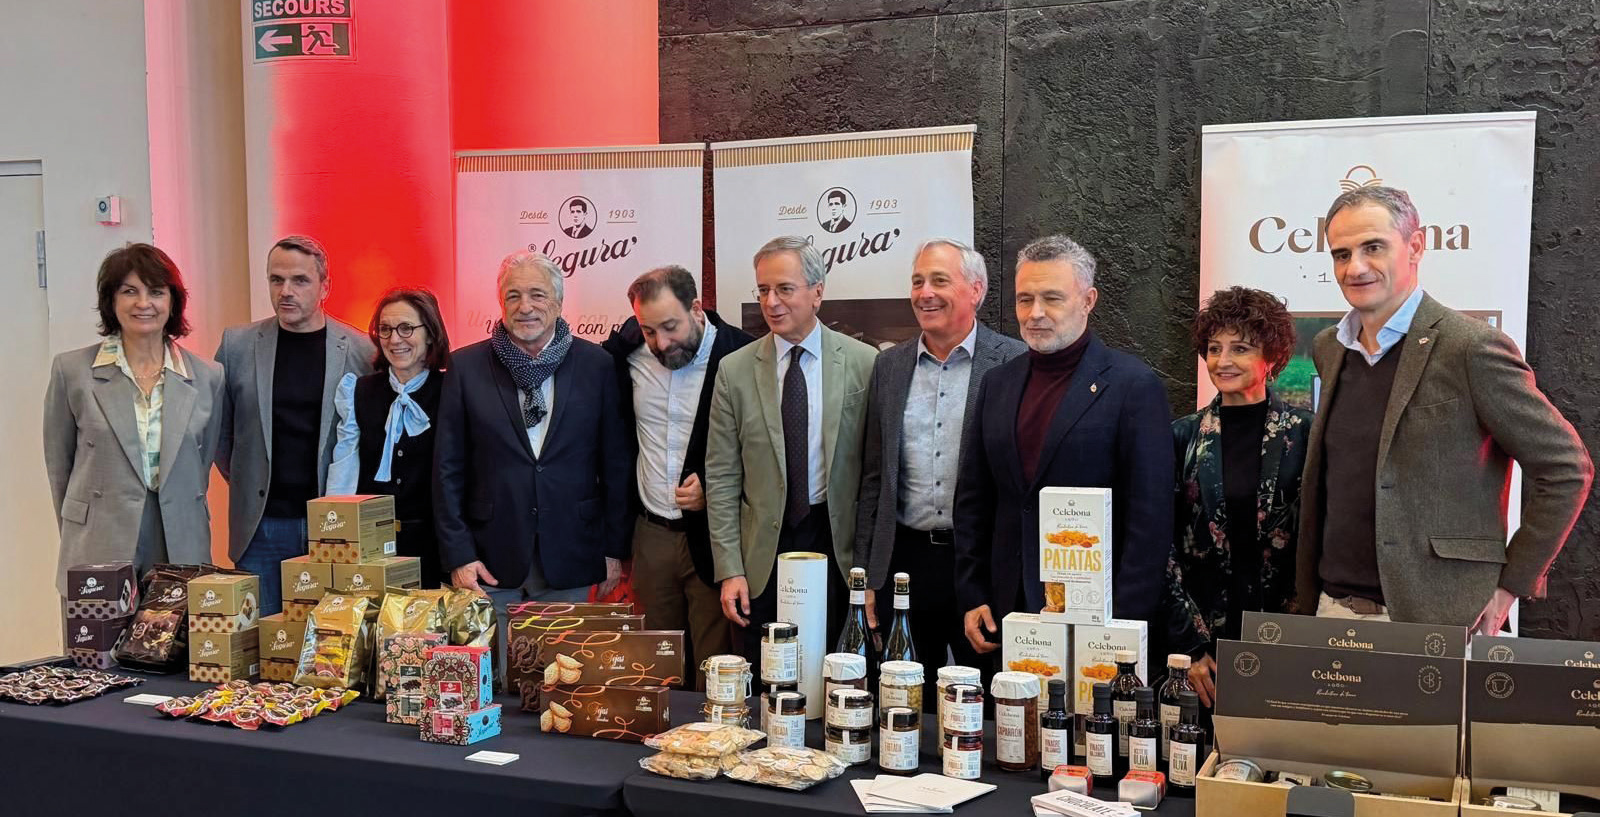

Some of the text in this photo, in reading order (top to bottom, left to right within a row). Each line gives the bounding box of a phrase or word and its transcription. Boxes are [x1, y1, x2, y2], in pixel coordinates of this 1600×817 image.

[254, 0, 346, 18] SECOURS
[778, 199, 898, 216] Desde 1903
[520, 209, 636, 220] Desde 1903
[1248, 216, 1472, 254] Celna
[577, 322, 607, 335] con
[1052, 507, 1091, 517] Celebona
[1043, 547, 1102, 572] PATATAS
[1014, 635, 1052, 647] Celebona
[1087, 641, 1127, 651] Celebona
[1328, 637, 1374, 650] Celebona
[1311, 669, 1362, 684] Celebona
[1133, 755, 1149, 766] OLIVA
[1172, 759, 1188, 772] OLIVA
